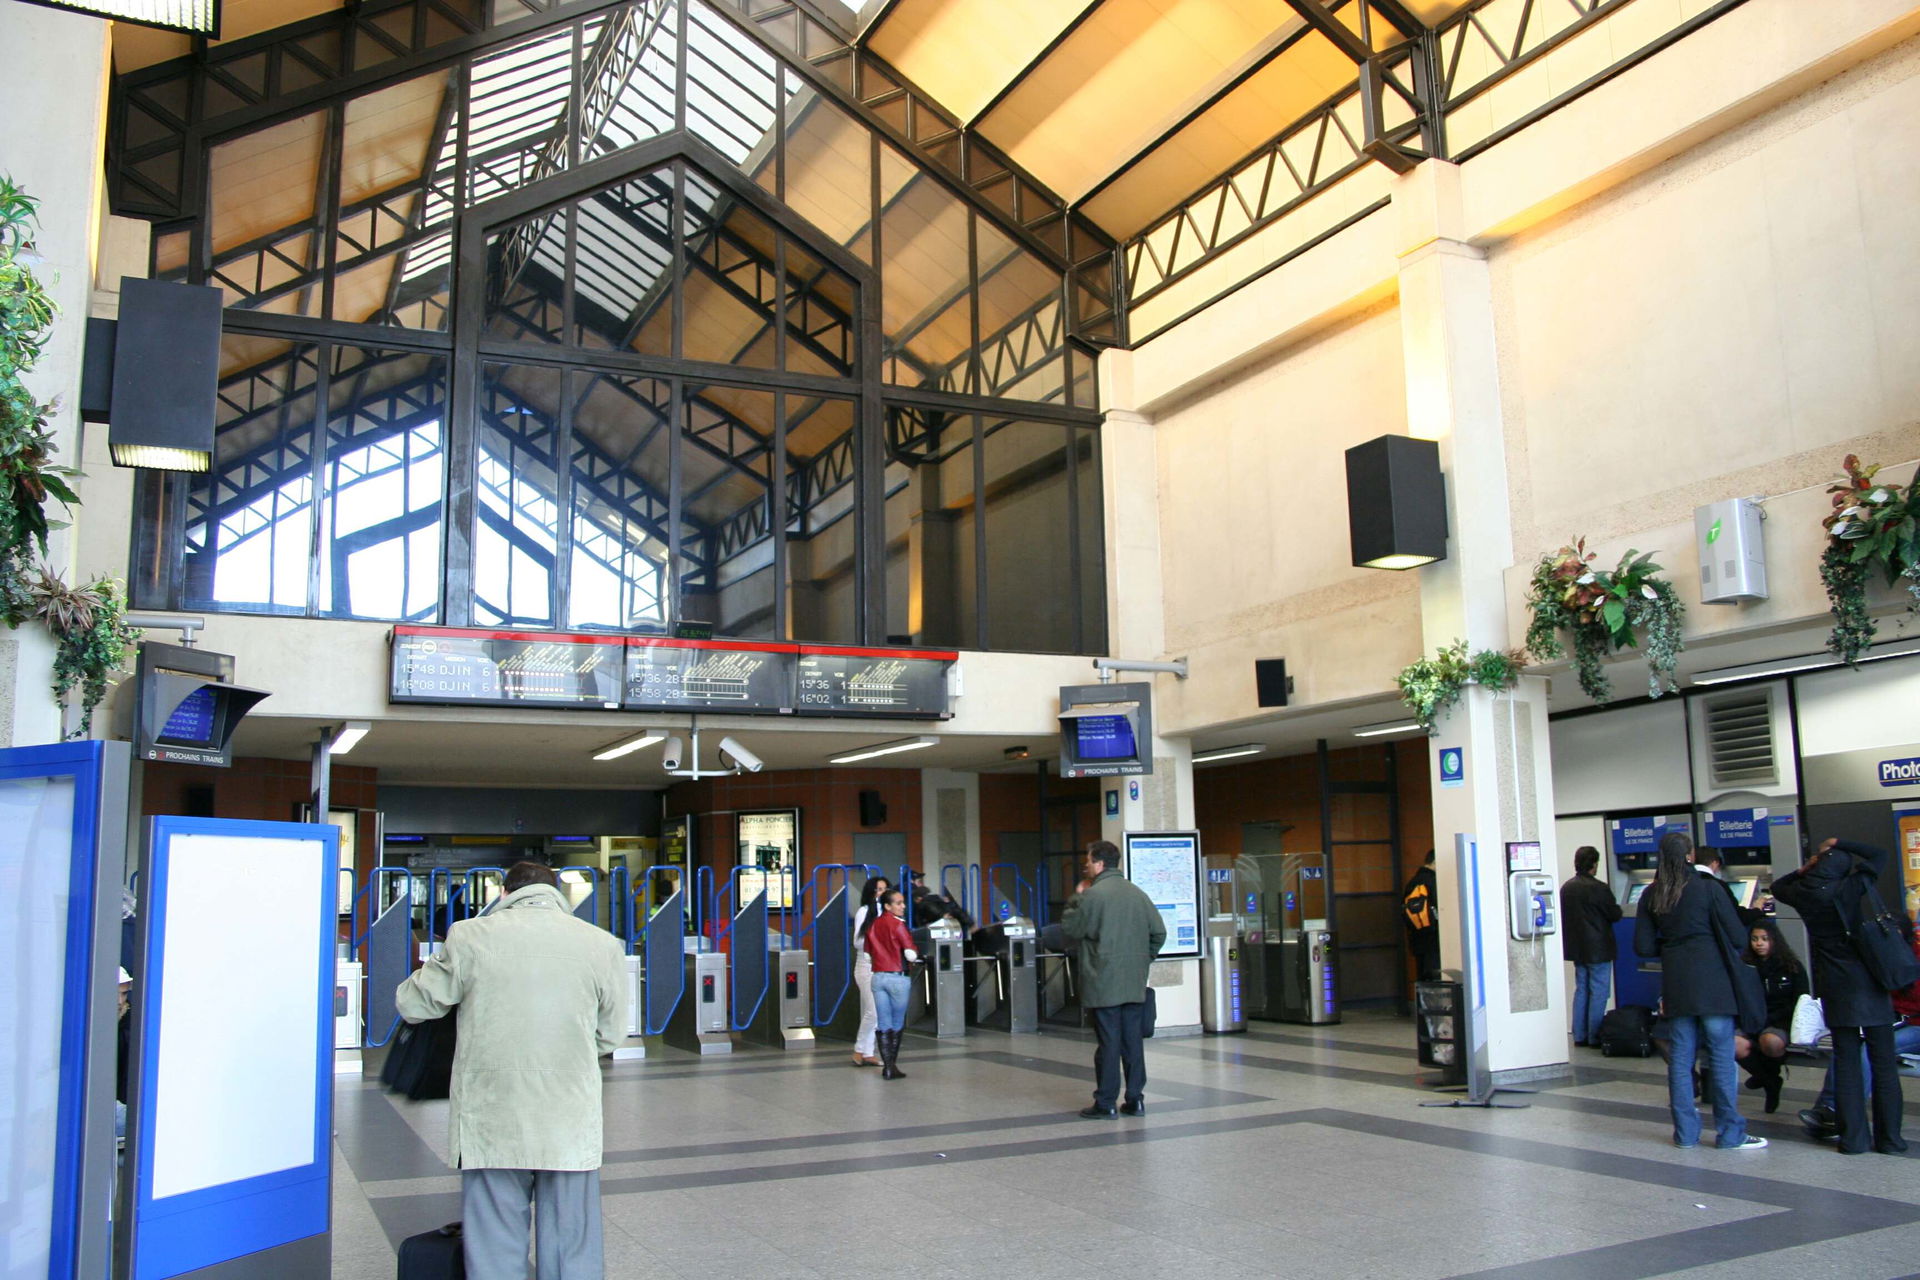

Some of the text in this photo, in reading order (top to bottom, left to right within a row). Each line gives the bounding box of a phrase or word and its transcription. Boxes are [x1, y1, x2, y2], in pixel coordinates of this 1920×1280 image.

[440, 665, 471, 676] DJIN
[482, 666, 490, 677] 6
[440, 681, 470, 691] DJIN
[482, 682, 490, 692] 6
[841, 681, 846, 690] 1
[841, 695, 846, 704] 1
[165, 751, 224, 764] PROCHAINS TRAINS
[1084, 767, 1119, 775] PROCHAINS
[740, 816, 763, 824] ALPHA
[1719, 820, 1752, 831] Billetterie
[1624, 828, 1653, 838] Billetterie
